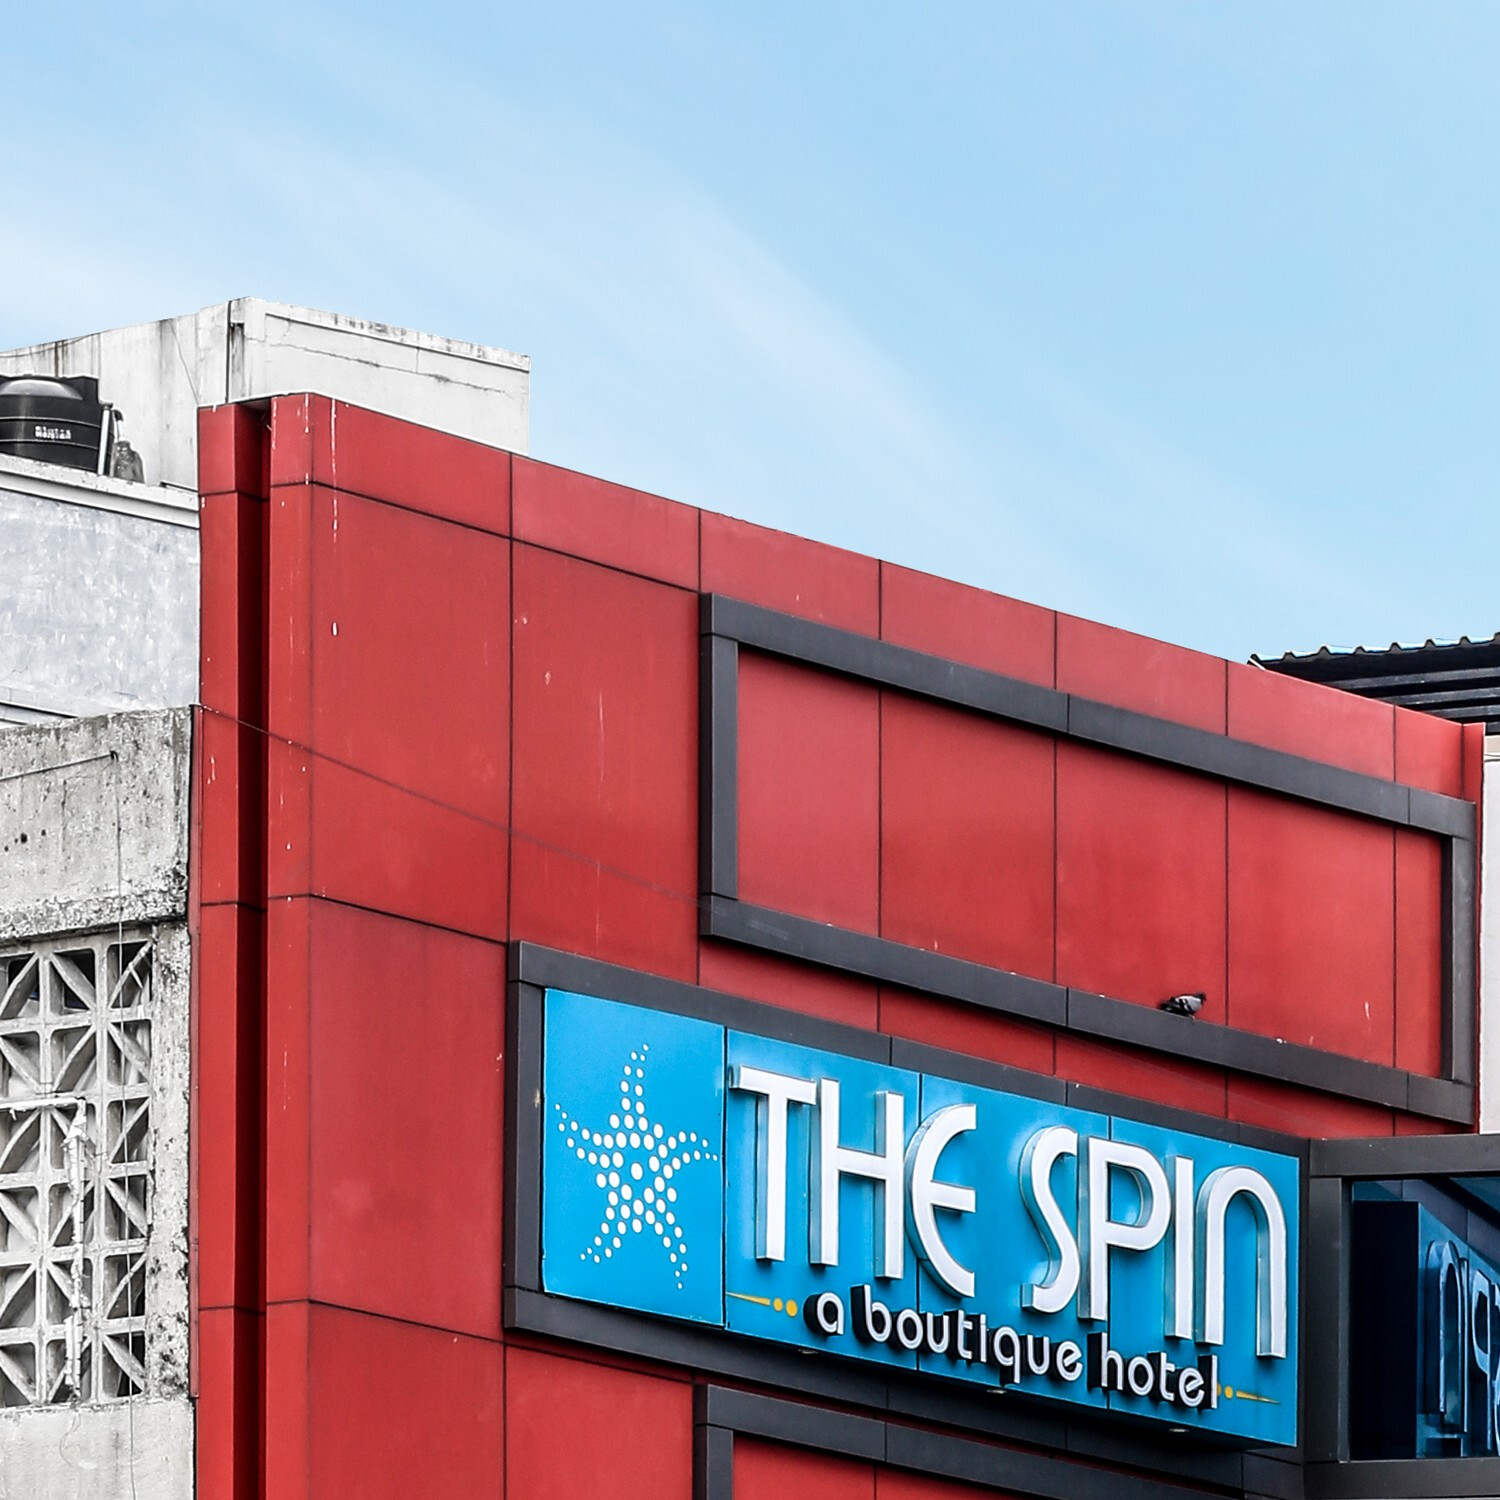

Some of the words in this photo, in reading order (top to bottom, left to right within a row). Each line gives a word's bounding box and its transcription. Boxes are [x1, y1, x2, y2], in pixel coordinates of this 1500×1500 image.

[728, 1064, 977, 1299] THE
[1020, 1125, 1288, 1359] SPIN
[810, 1292, 845, 1336] a
[858, 1284, 1083, 1386] boutique
[1098, 1332, 1219, 1410] hotel
